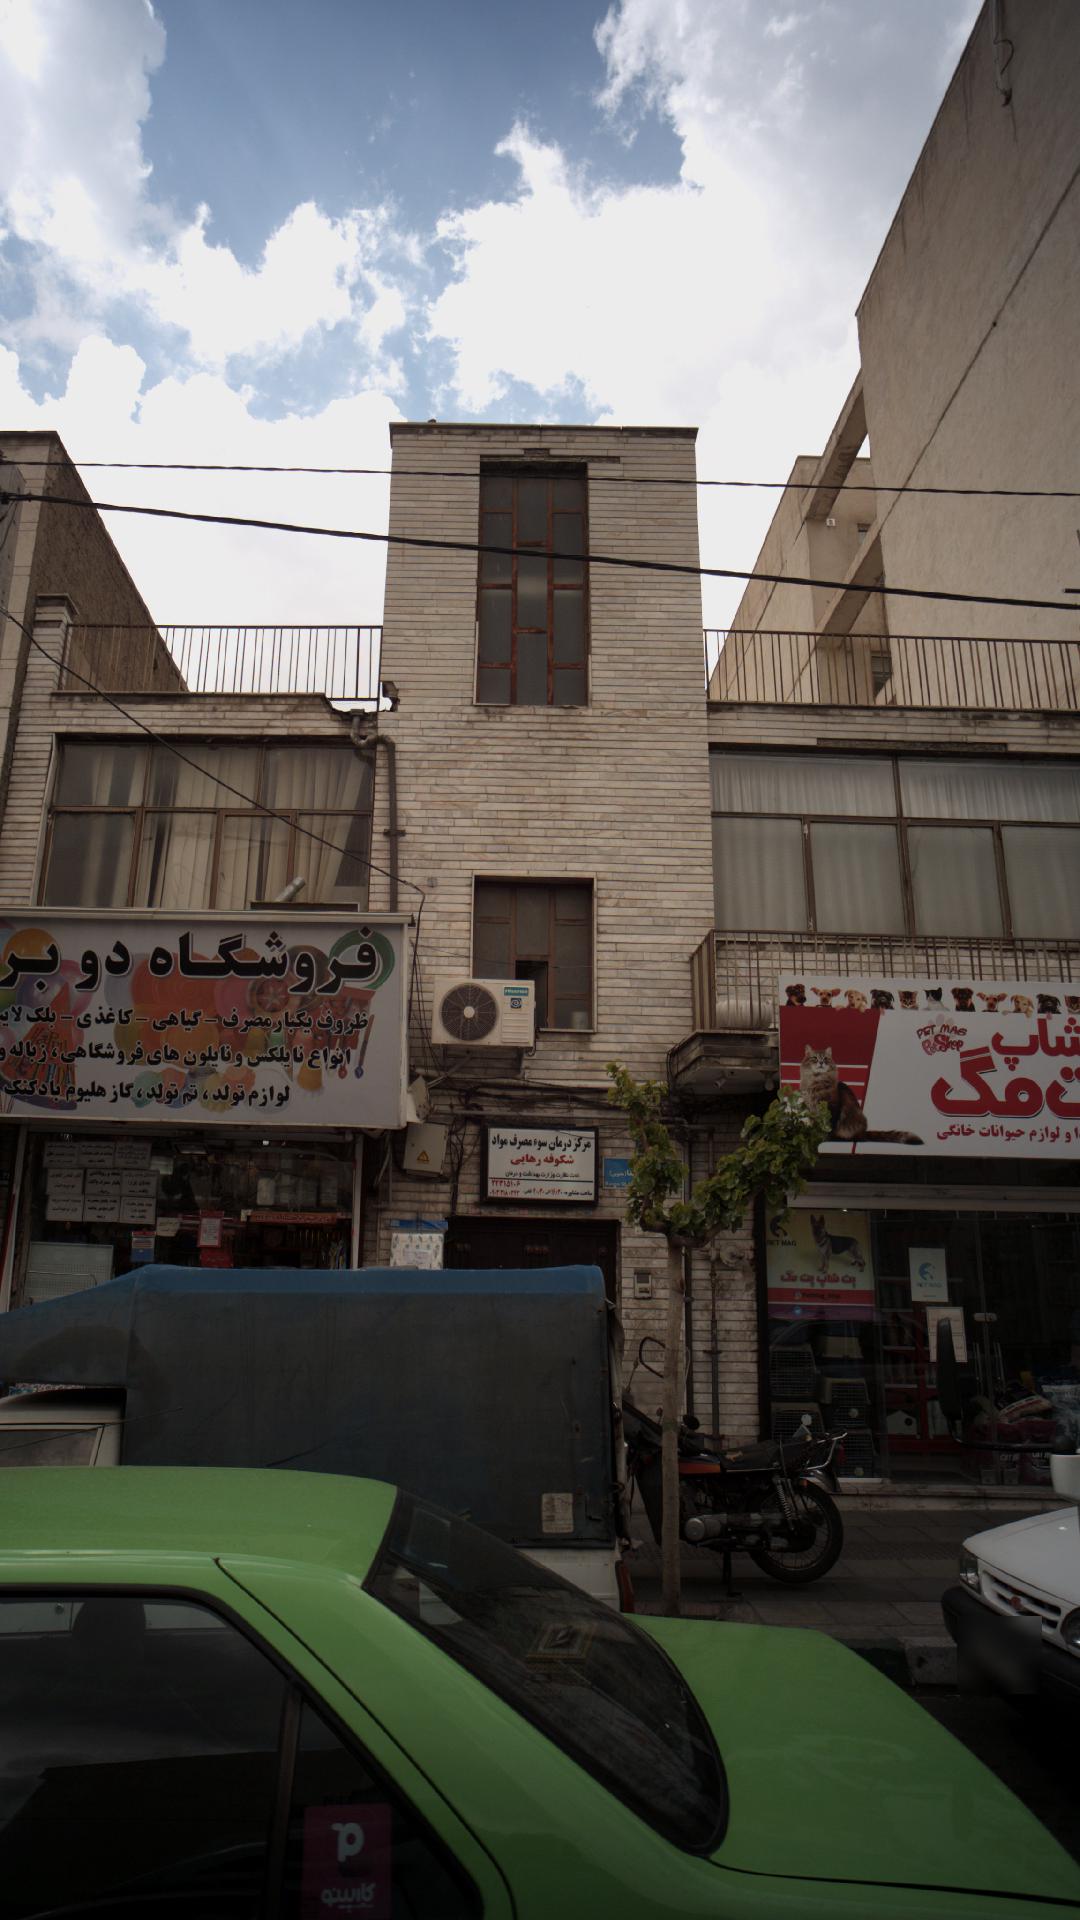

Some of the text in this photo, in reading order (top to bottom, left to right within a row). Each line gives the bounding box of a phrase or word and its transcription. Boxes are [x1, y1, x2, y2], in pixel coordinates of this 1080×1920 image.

[75, 940, 131, 989] دو
[149, 926, 377, 994] فروشگاه
[0, 1006, 21, 1027] لای
[26, 1007, 56, 1028] بلک
[77, 1007, 133, 1028] کاغذی
[152, 1010, 201, 1031] گیاهی
[223, 1009, 271, 1033] مصرف
[317, 1010, 368, 1034] ظروف
[10, 1041, 47, 1063] زباله
[147, 1045, 179, 1065] های
[184, 1046, 231, 1067] نایلون
[235, 1051, 243, 1067] و
[247, 1046, 304, 1068] نایلکس
[308, 1048, 350, 1069] انواع
[66, 1081, 106, 1103] هلیوم
[931, 1047, 1043, 1118] مگ
[183, 1084, 198, 1104] تم
[248, 1085, 290, 1106] لوازم
[492, 1133, 591, 1152] مرکز درمان سوء مصرف مواد
[937, 1124, 975, 1140] خانگی
[979, 1124, 1025, 1142] حیوانات
[1029, 1126, 1060, 1143] لوازم
[1065, 1130, 1071, 1143] و
[511, 1153, 574, 1167] شکوفه رهایی
